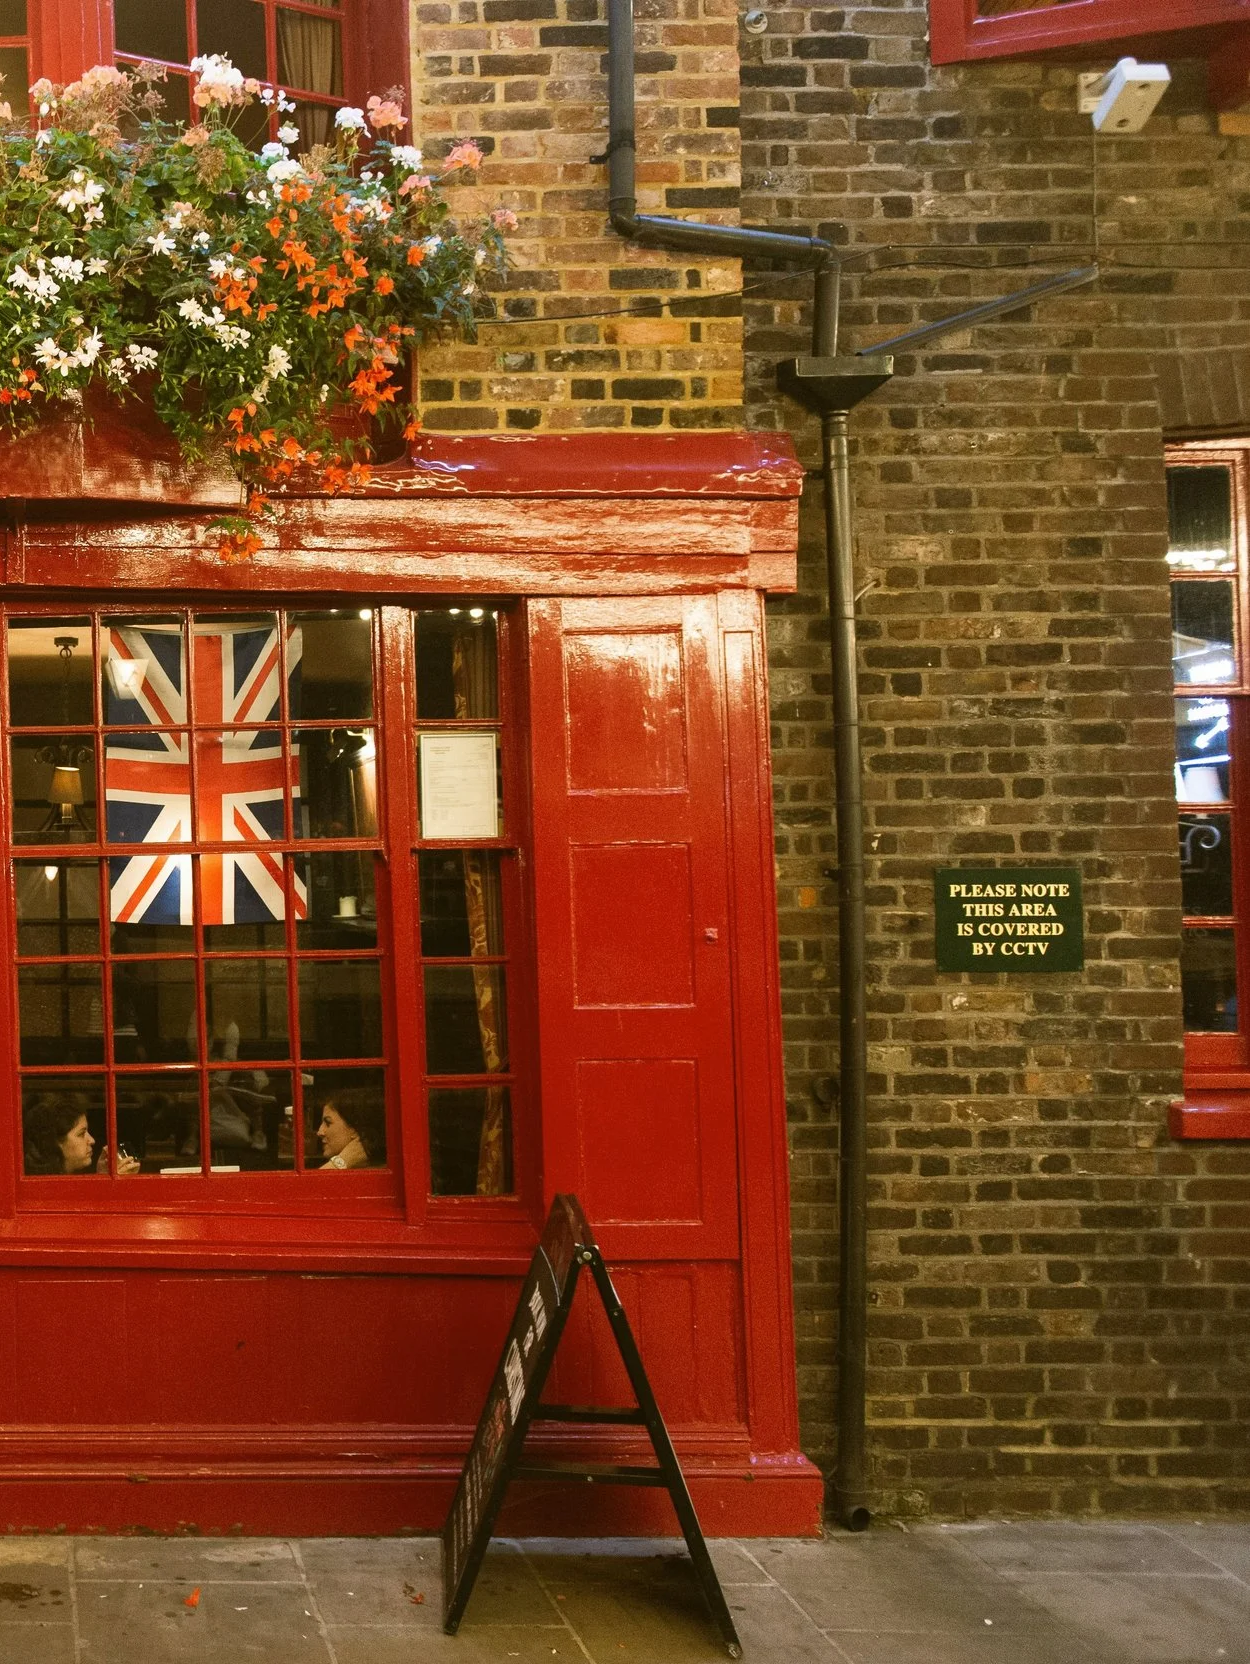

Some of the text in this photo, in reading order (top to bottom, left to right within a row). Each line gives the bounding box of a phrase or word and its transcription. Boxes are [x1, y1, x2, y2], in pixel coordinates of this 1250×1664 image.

[949, 884, 1070, 897] PLEASE NOTE
[962, 903, 1057, 916] THIS AREA
[957, 923, 1064, 936] IS COVERED
[972, 942, 1049, 955] BY CCTV
